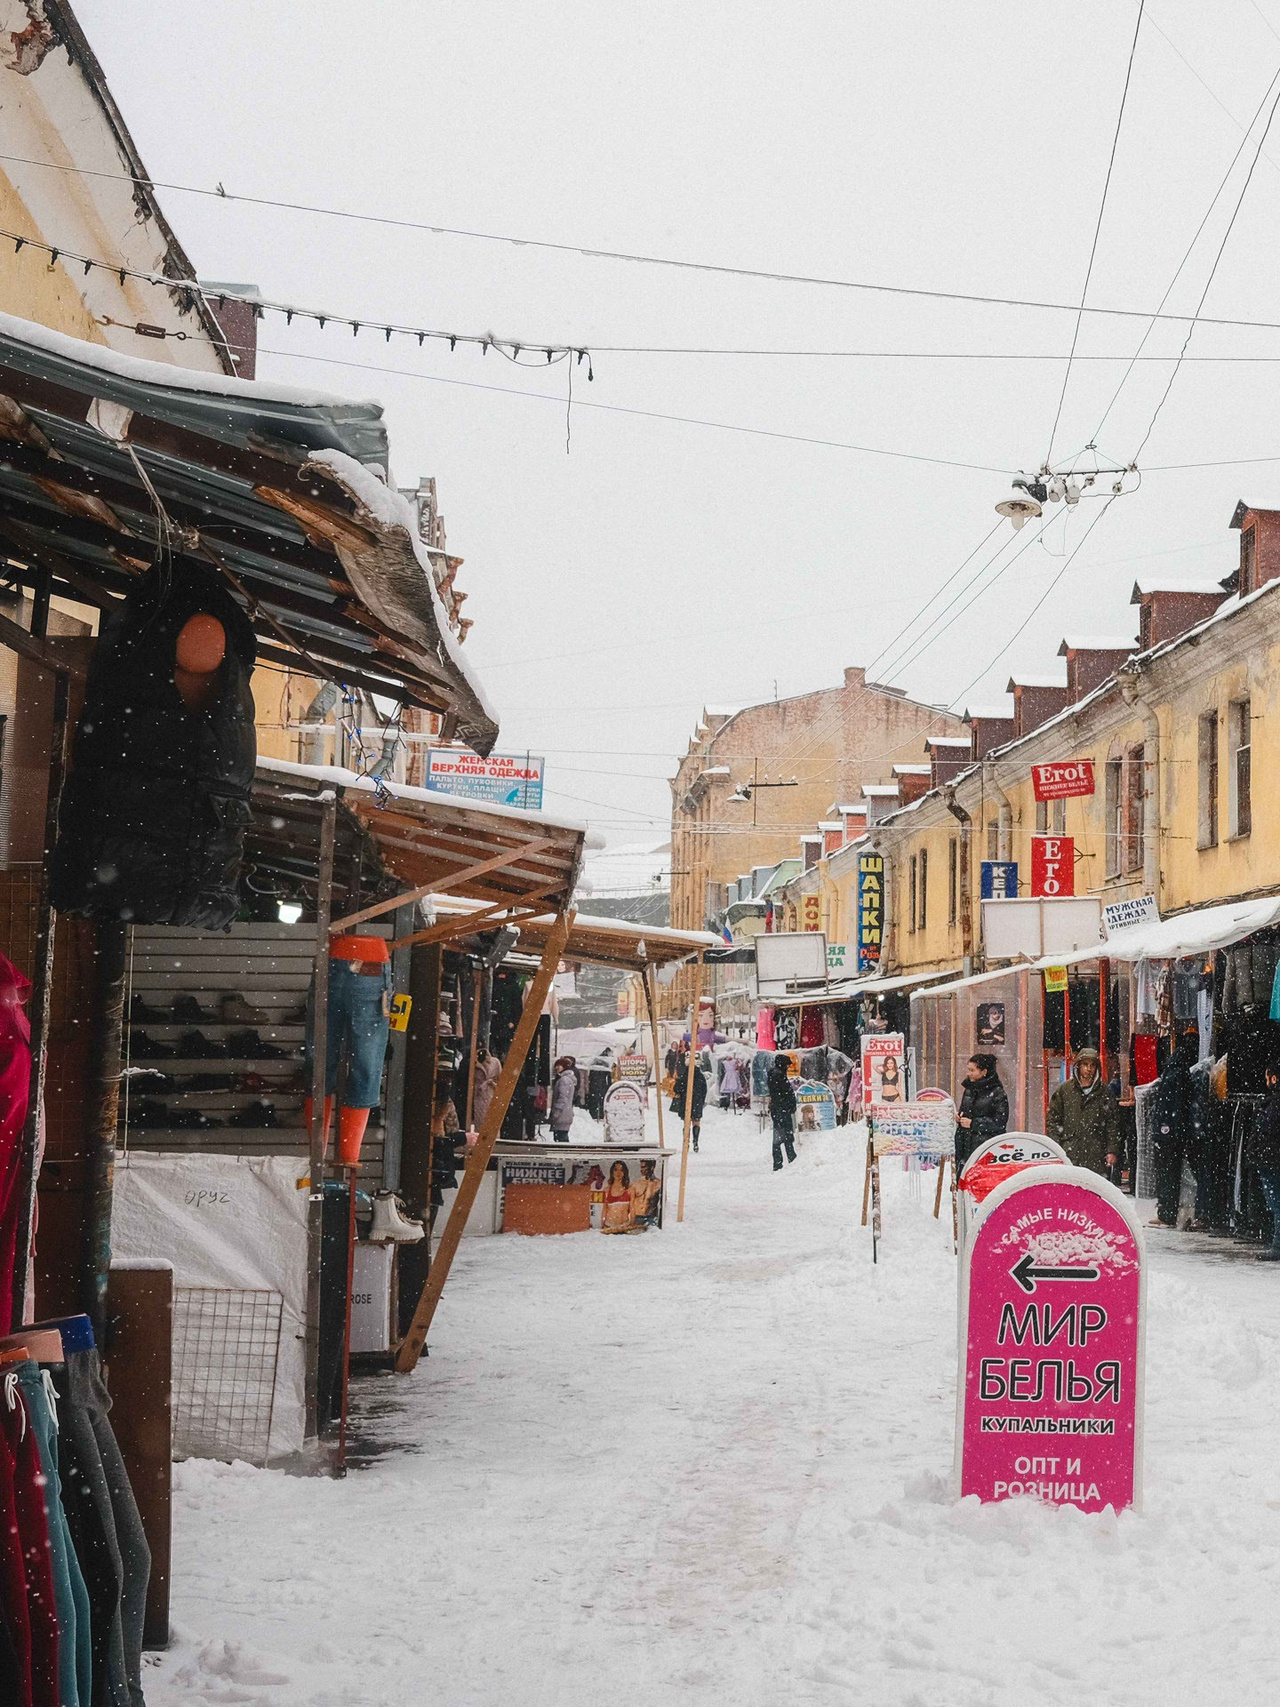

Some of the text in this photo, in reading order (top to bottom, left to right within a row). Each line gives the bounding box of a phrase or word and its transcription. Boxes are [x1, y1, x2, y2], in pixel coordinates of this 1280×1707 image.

[432, 763, 540, 779] ВЕРХНЯЯ ОДЕЖДА
[459, 755, 514, 767] ЖЕНСКАЯ
[1038, 763, 1087, 784] Erot
[860, 857, 883, 944] ШАПКИ
[1105, 897, 1154, 915] МУЖСКАЯ
[866, 1039, 901, 1051] Erot
[506, 1168, 563, 1179] НИЖНЕЕ
[1001, 1207, 1054, 1245] САМЫЕ
[997, 1302, 1107, 1347] МИР
[979, 1357, 1121, 1404] БЕЛЬЯ
[981, 1416, 1115, 1436] КУПАЛЬНИКИ
[1014, 1456, 1081, 1475] ОПТ И
[993, 1481, 1101, 1503] РОЗНИЦА
